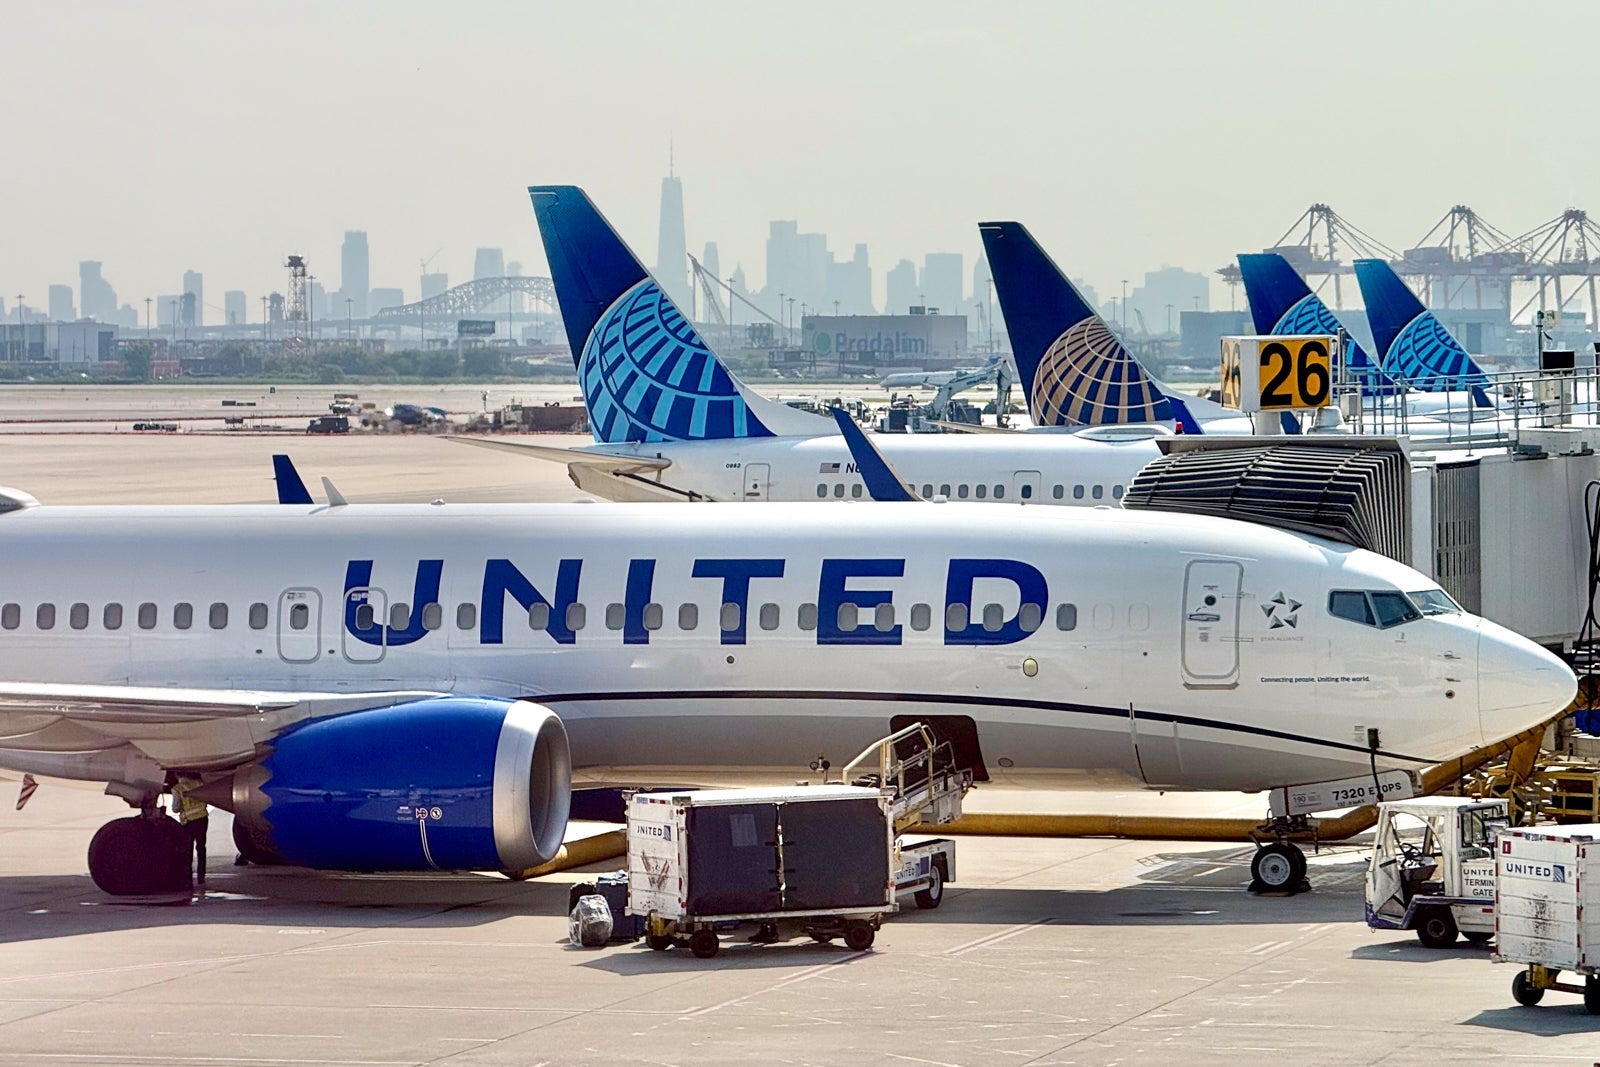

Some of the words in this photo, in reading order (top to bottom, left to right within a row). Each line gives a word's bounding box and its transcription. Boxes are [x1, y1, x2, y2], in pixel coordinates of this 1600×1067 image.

[835, 331, 925, 353] Prodalim
[1260, 341, 1330, 406] 26
[344, 558, 1050, 647] UNITED
[1260, 676, 1293, 684] Connecting
[1317, 676, 1339, 684] Uniting
[1340, 675, 1350, 683] the
[1332, 788, 1365, 801] 7320
[1463, 868, 1494, 876] UNITE
[1506, 863, 1551, 877] UNITED
[1464, 878, 1495, 887] TERMIN
[1472, 888, 1494, 897] GATE
